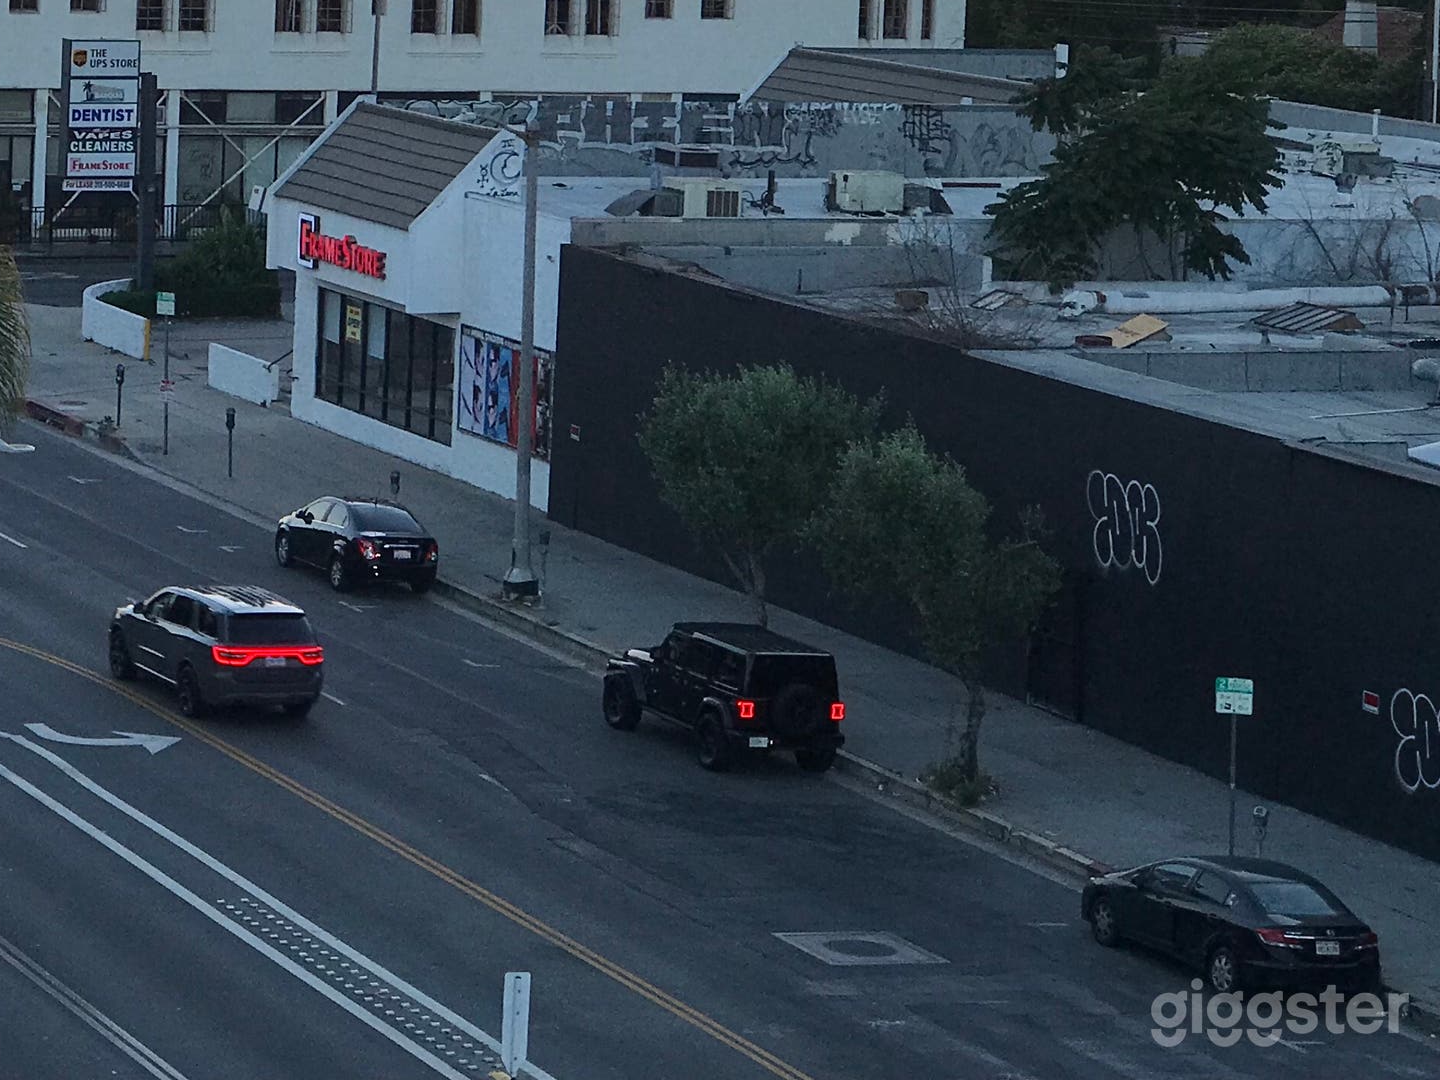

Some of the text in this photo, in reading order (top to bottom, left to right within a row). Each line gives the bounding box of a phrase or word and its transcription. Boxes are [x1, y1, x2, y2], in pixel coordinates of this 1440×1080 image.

[90, 49, 108, 58] THE
[90, 59, 137, 69] UPS STORE
[71, 108, 134, 122] DENTIST
[73, 130, 133, 139] VAPES
[70, 141, 134, 152] CLEANERS
